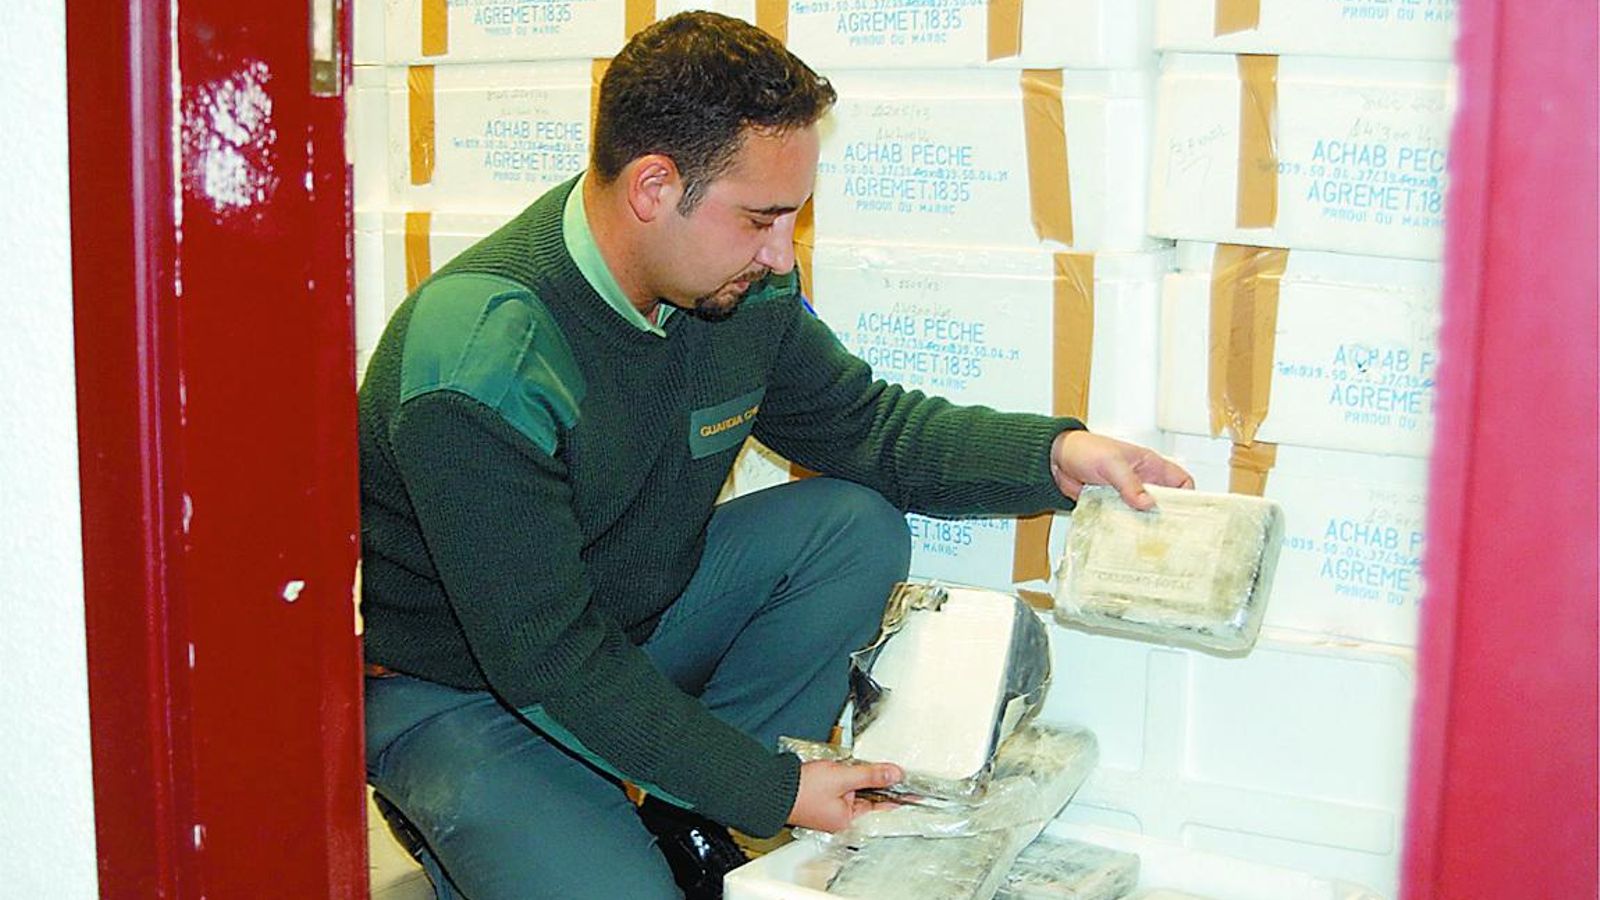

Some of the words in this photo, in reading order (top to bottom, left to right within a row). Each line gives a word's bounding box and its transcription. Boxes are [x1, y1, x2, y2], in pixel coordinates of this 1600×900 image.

[836, 9, 962, 33] AGREMET.1835
[485, 120, 529, 139] ACHAB
[536, 121, 583, 142] PECHE
[484, 149, 581, 172] AGREMET.1835
[844, 142, 902, 164] ACHAB
[911, 144, 973, 167] PECHE
[1312, 138, 1387, 169] ACHAB
[844, 177, 970, 201] AGREMET.1835
[857, 312, 915, 337] ACHAB
[924, 319, 985, 344] PECHE
[857, 347, 982, 378] AGREMET.1835
[1324, 518, 1399, 550] ACHAB
